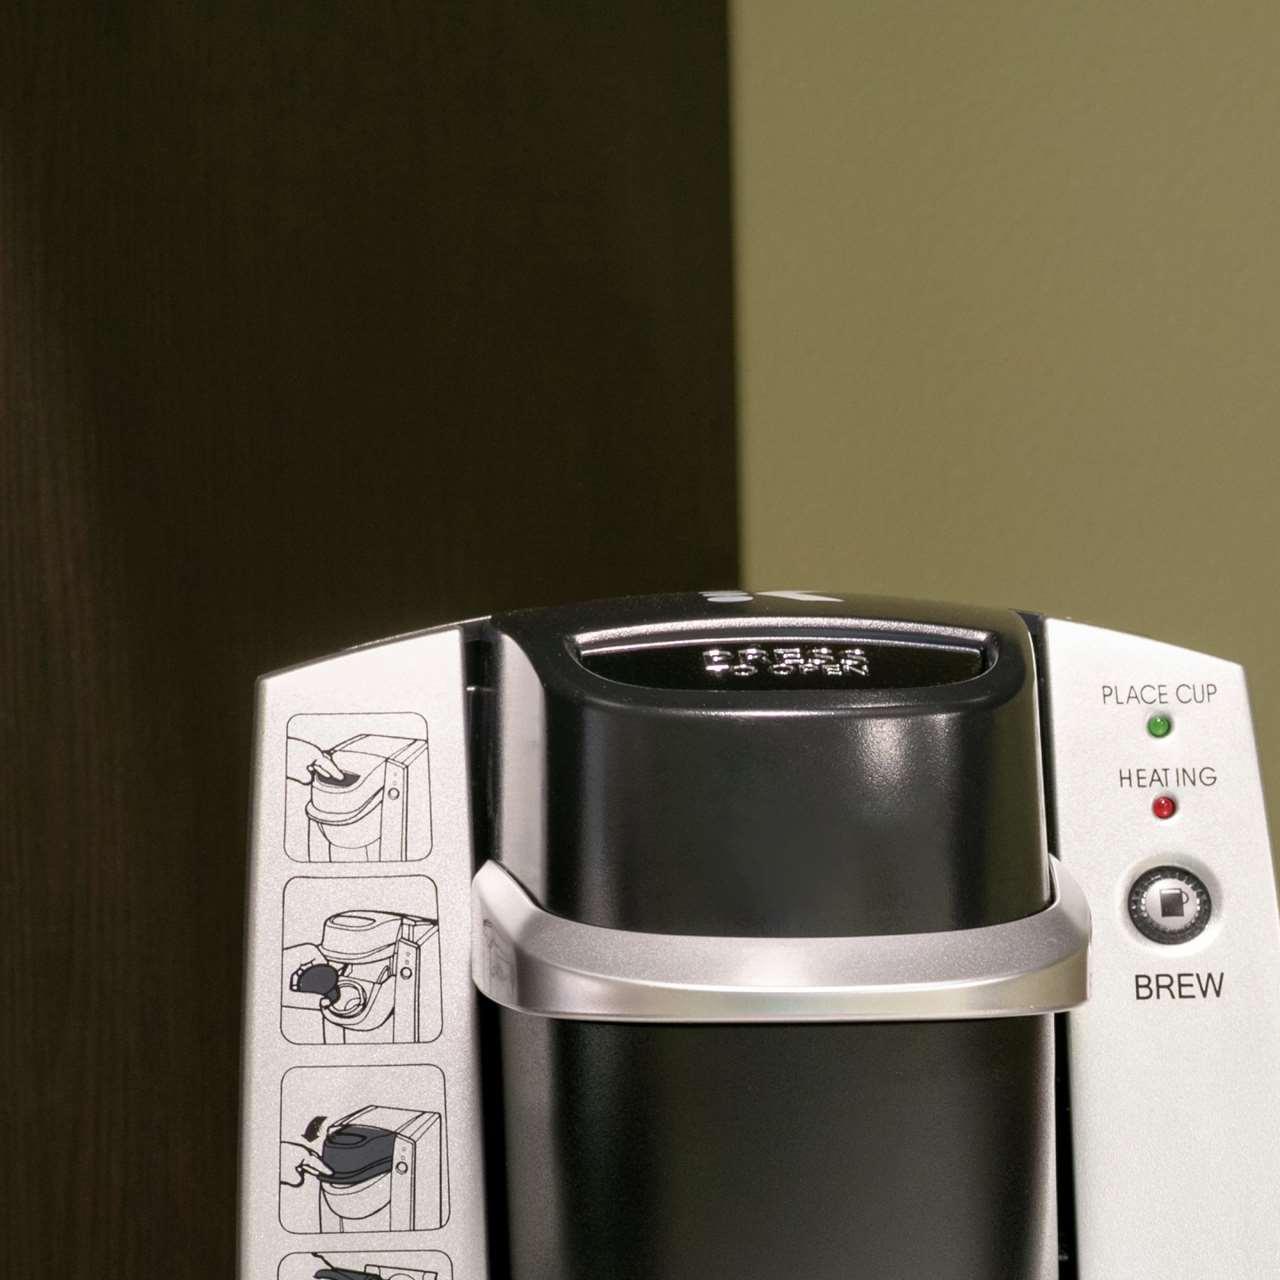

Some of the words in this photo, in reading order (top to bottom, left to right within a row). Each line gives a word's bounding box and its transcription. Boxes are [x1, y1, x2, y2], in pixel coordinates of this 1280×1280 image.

[1102, 684, 1169, 705] PLACE
[1175, 683, 1218, 704] CUP
[1119, 766, 1218, 788] HEATING
[1134, 972, 1225, 1001] BREW
